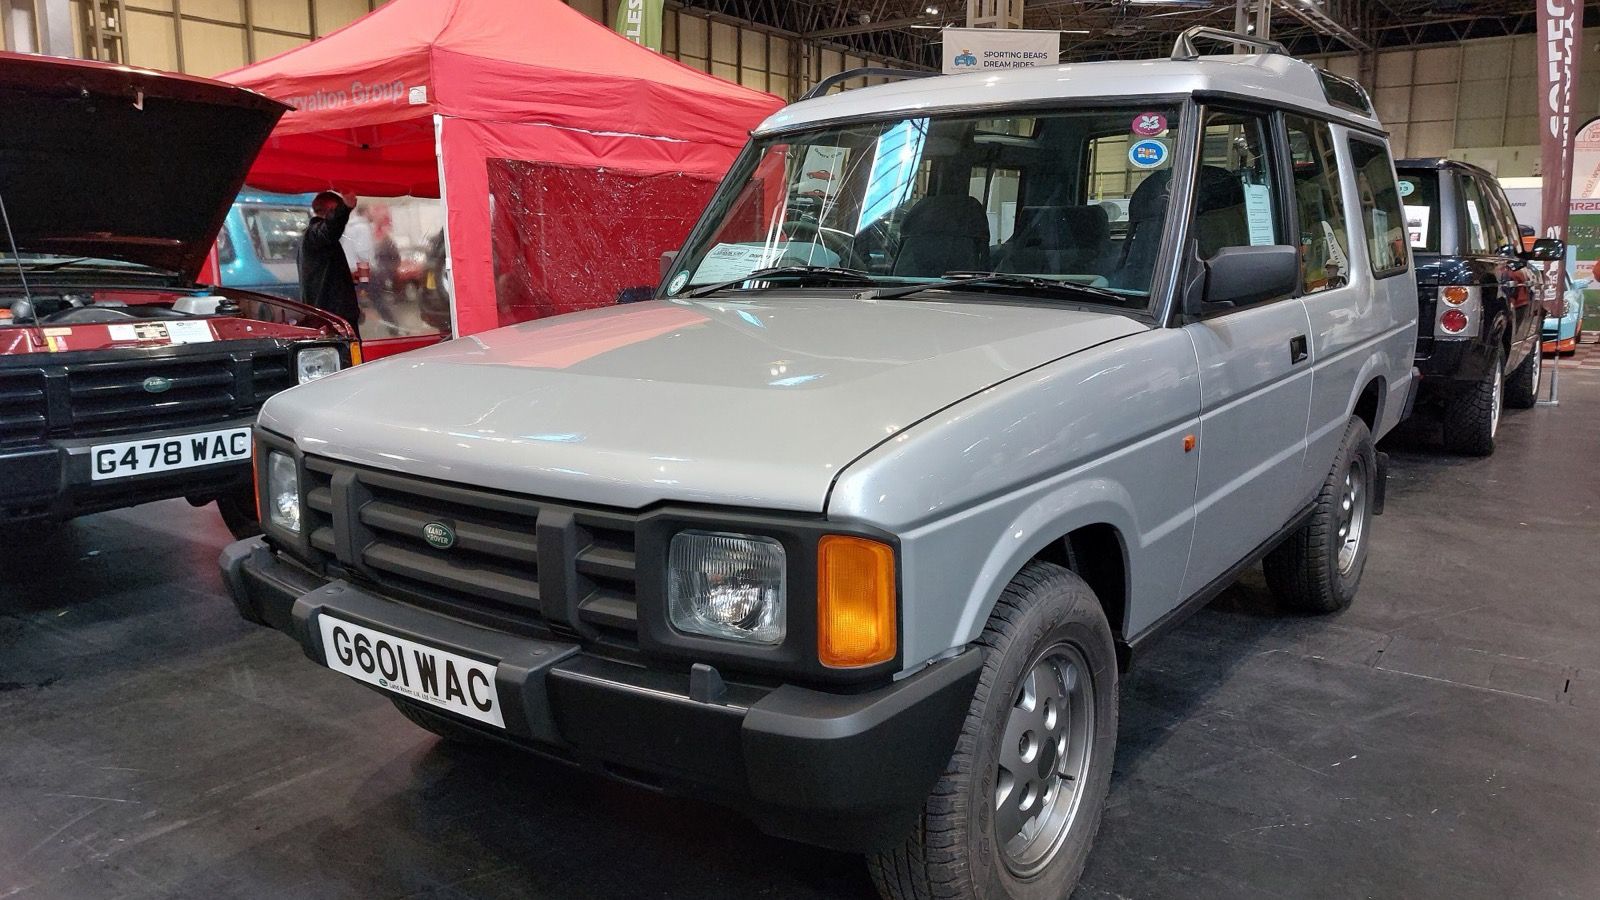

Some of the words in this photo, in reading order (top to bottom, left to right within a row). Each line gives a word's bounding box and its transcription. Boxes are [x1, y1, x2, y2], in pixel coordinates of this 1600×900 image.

[983, 51, 1022, 59] SPORTING
[1023, 51, 1048, 60] BEARS
[983, 60, 1011, 68] DREAM
[351, 80, 404, 105] Group
[96, 440, 183, 474] G478
[190, 432, 247, 462] WAC
[428, 526, 443, 536] LAND
[429, 534, 449, 544] ROVER
[332, 625, 410, 687] G601
[413, 649, 493, 713] WAC
